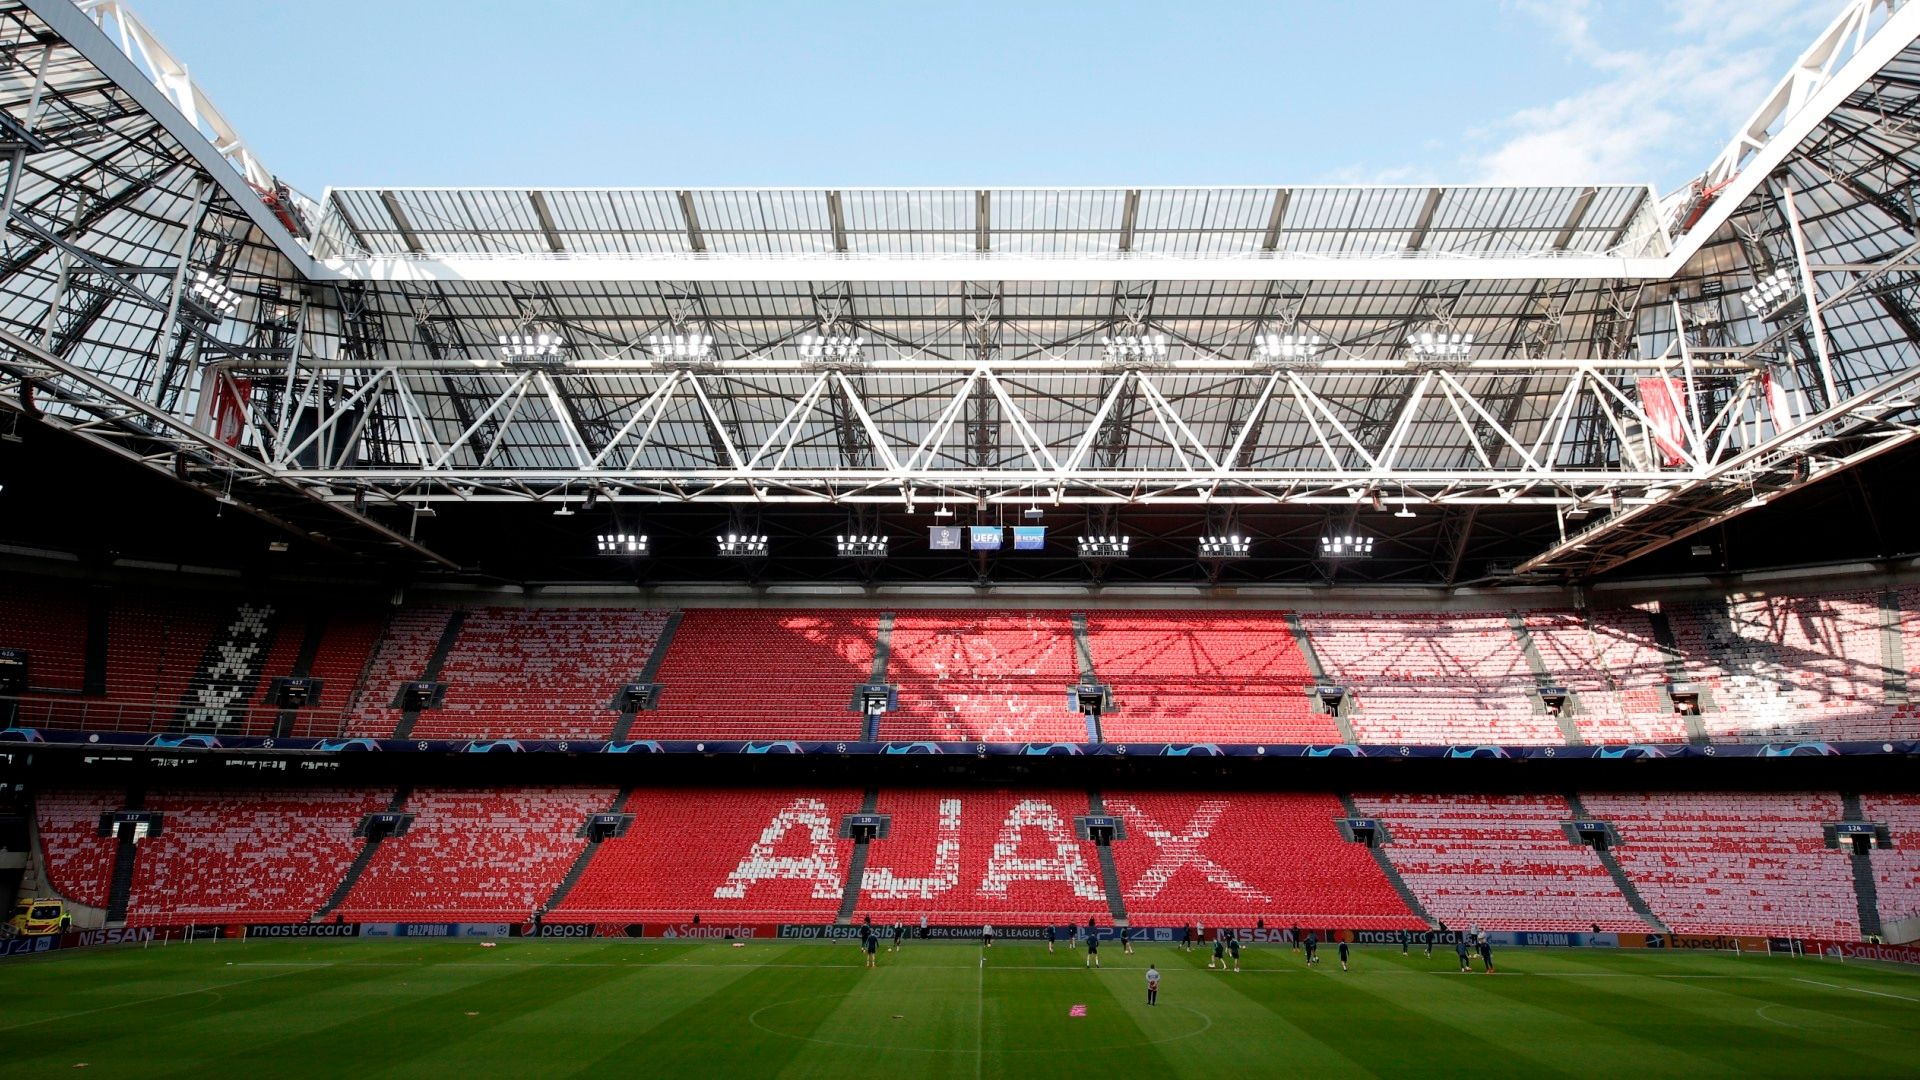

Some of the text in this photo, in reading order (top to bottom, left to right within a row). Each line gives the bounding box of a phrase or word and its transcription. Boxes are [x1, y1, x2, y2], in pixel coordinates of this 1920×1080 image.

[974, 534, 1000, 542] UEFA
[714, 799, 1272, 902] AJAX
[252, 923, 354, 936] mastercard
[407, 924, 449, 936] GAZPROM
[541, 924, 588, 938] pepsi
[679, 924, 757, 938] Santander
[782, 925, 820, 938] Enjoy
[1006, 929, 1040, 937] LEAGUE
[1157, 930, 1170, 938] Pro
[79, 927, 156, 946] NISSAN
[1526, 933, 1569, 945] GAZPROM
